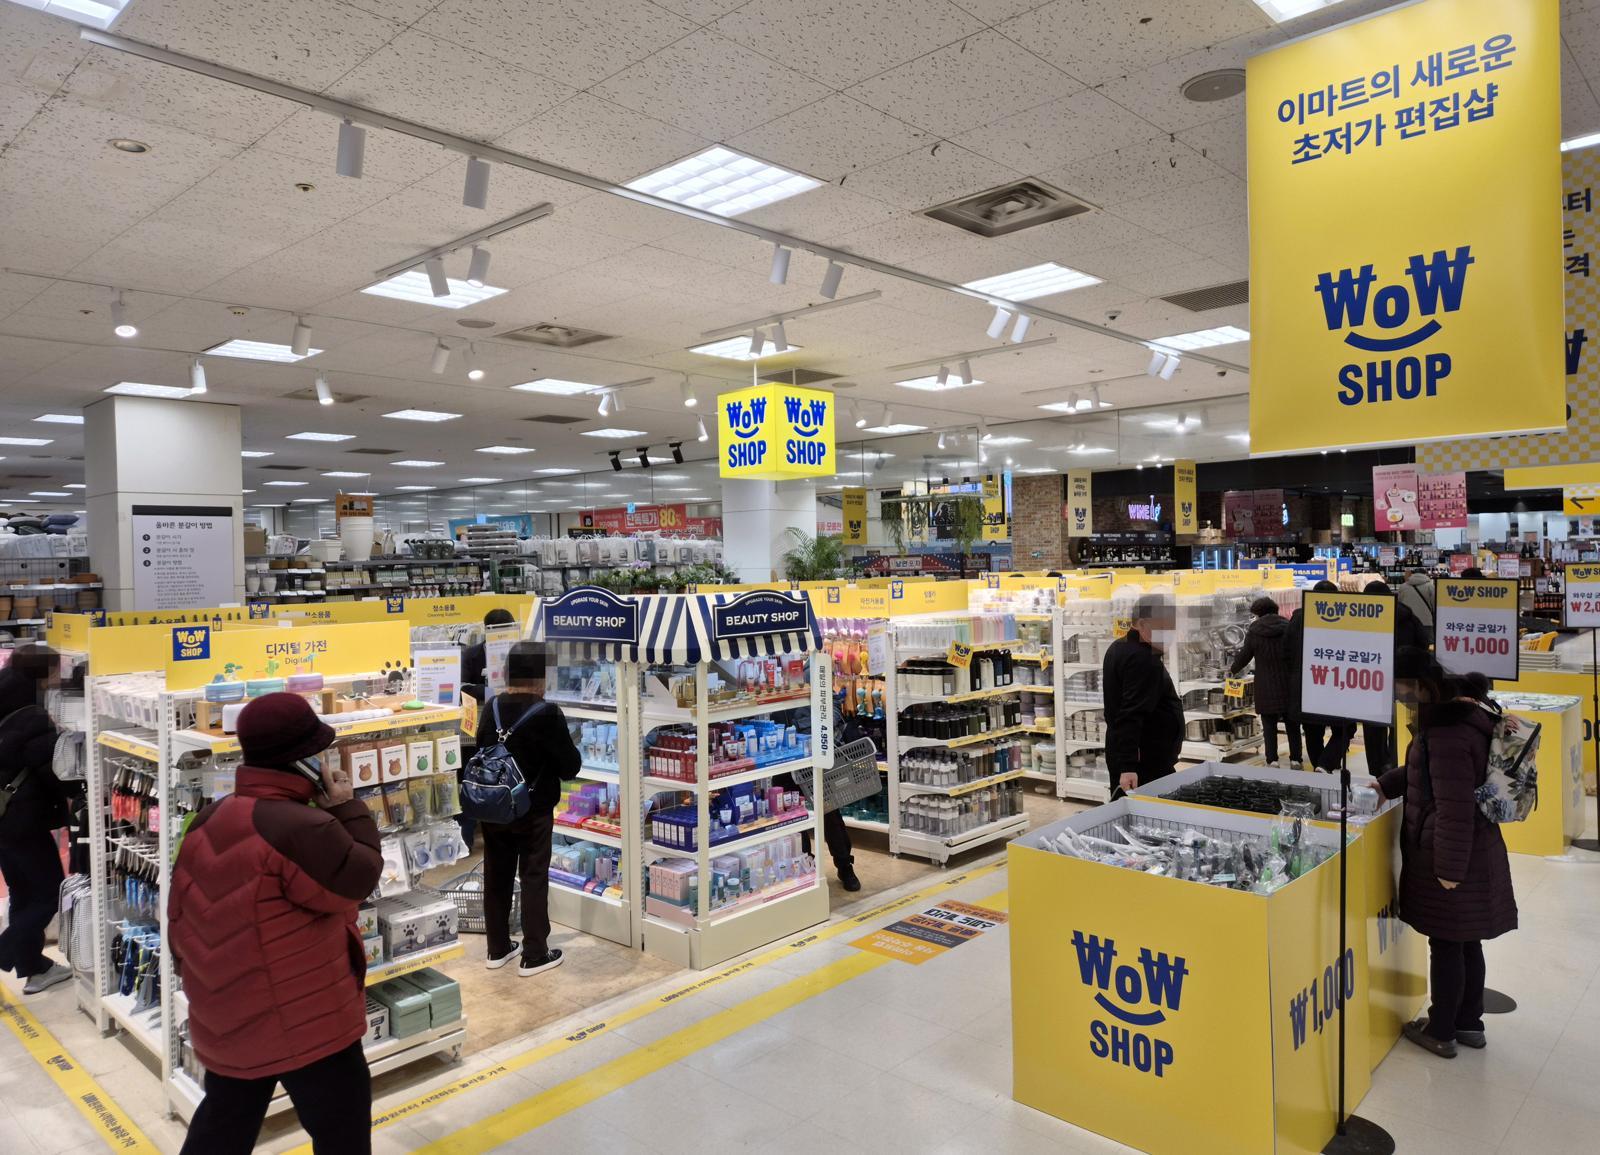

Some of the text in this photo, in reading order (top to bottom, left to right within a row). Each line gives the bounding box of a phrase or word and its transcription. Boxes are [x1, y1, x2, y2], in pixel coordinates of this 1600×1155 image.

[1278, 34, 1516, 125] 이마트의 새로운
[1291, 82, 1499, 165] 초저가 편집샵
[1338, 353, 1451, 406] SHOP
[728, 440, 767, 468] SHOP
[786, 439, 826, 465] SHOP
[1477, 586, 1508, 599] SHOP
[571, 597, 588, 606] UPGRADE
[745, 597, 762, 605] UPGRADE
[726, 611, 799, 626] BEAUTY SHOP
[1349, 603, 1384, 618] SHOP
[553, 615, 626, 628] BEAUTY SHOP
[1446, 622, 1506, 634] 와우샵 균일가
[181, 648, 203, 657] SHOP
[266, 640, 327, 656] 디지털 가전
[1314, 648, 1381, 664] 와우샵 균일가
[1090, 1020, 1173, 1077] SHOP
[459, 1074, 486, 1088] 놀라운
[489, 1066, 507, 1077] 가격
